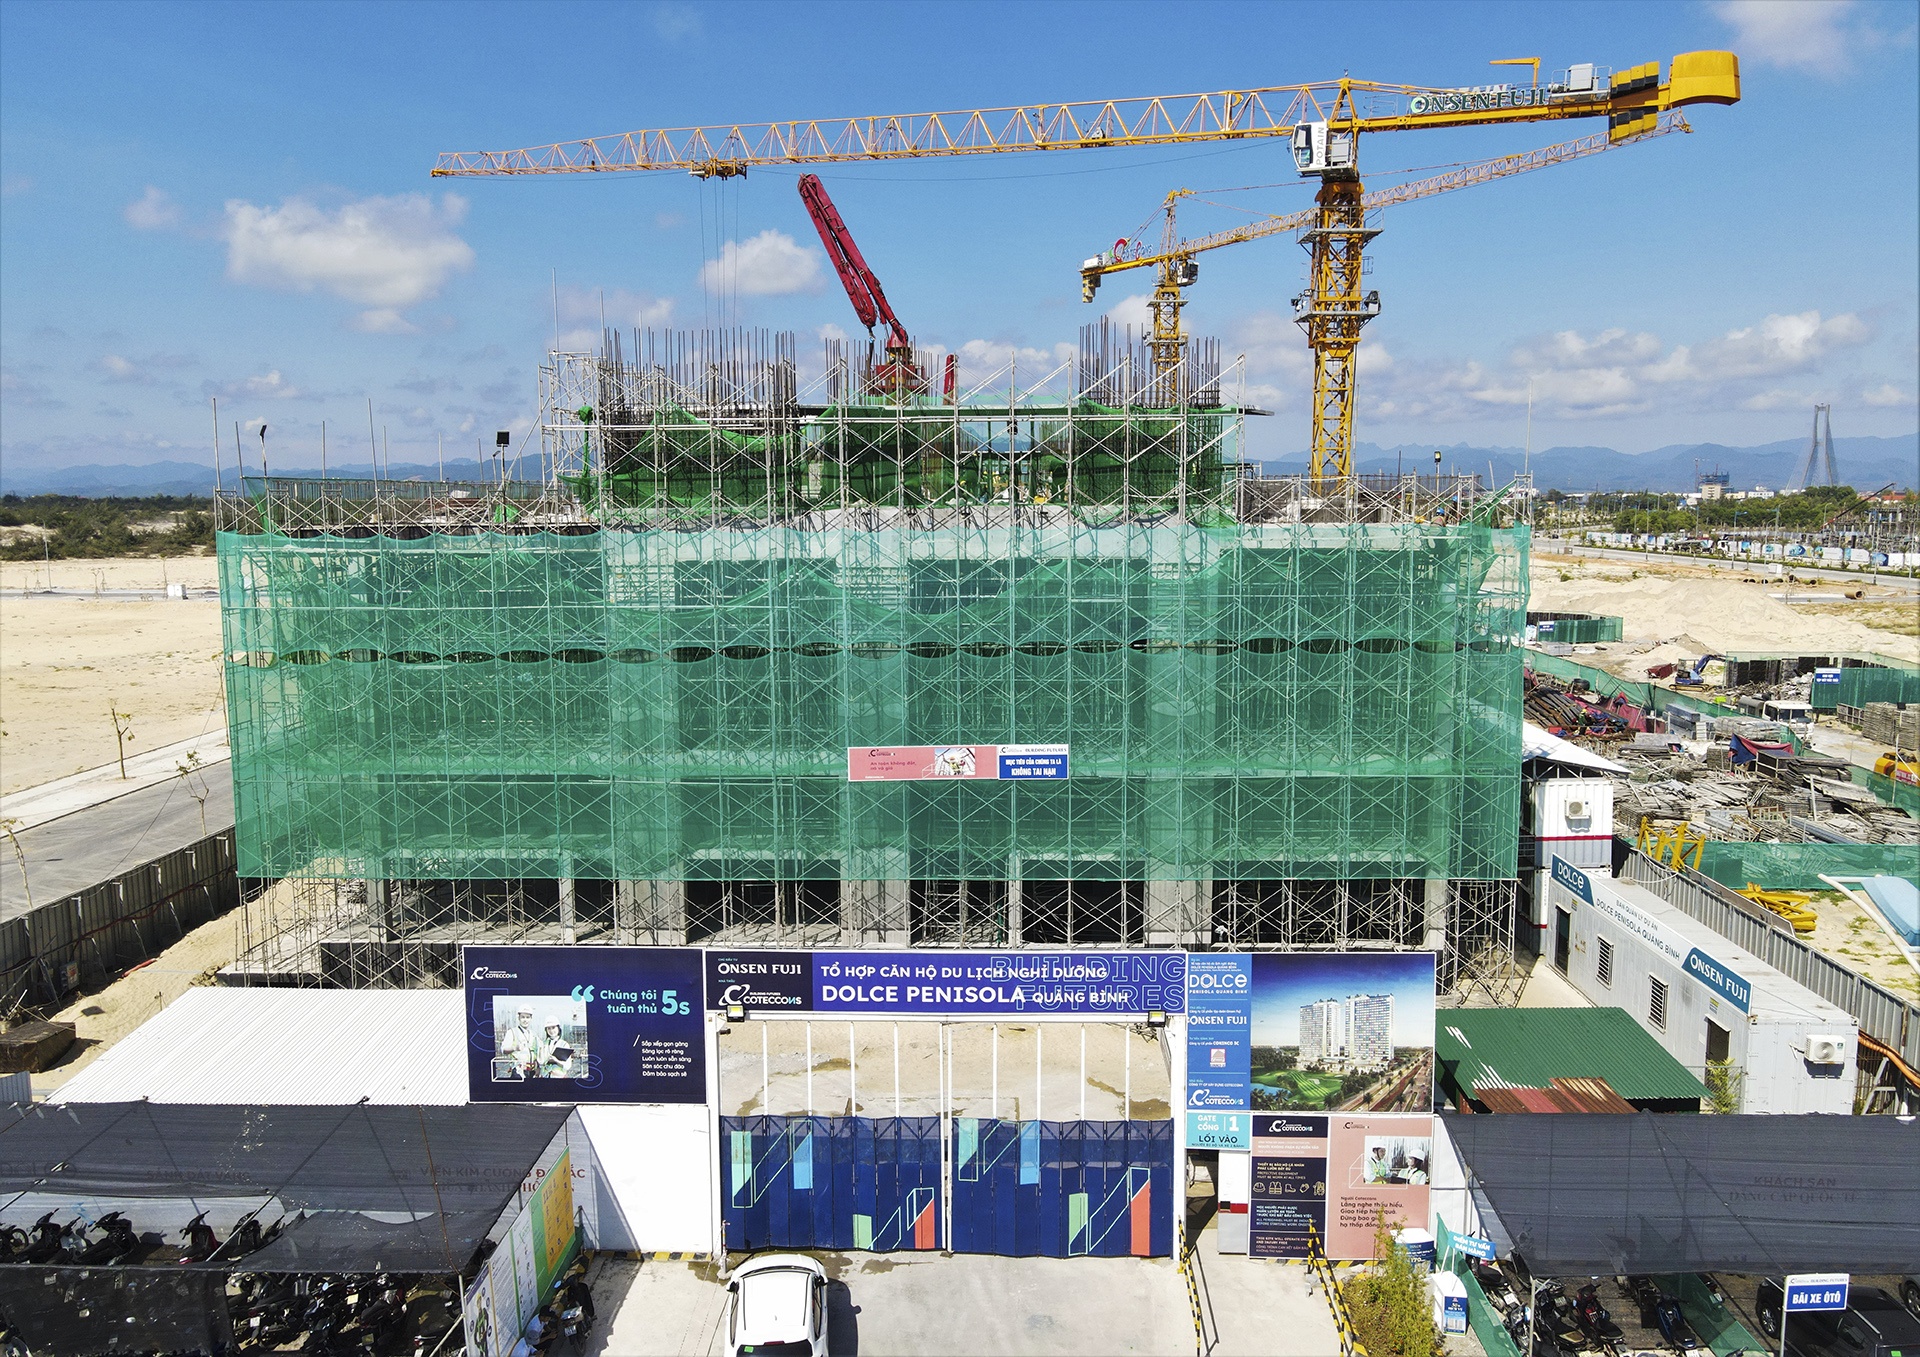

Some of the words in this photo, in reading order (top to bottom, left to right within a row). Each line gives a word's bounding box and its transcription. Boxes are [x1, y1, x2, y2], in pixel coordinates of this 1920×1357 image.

[1410, 93, 1491, 114] ONSEN
[1496, 88, 1547, 108] FUJI
[1315, 127, 1325, 165] POTAIN
[1011, 766, 1032, 776] KHÔNG
[1033, 767, 1042, 776] TAI
[1043, 767, 1056, 777] NẠN
[1596, 898, 1614, 917] DOLCE
[1614, 910, 1641, 936] PENISOLA
[717, 962, 768, 975] ONSEN
[771, 963, 802, 975] FUJI
[821, 961, 841, 978] TỔ
[845, 965, 876, 980] HỢP
[879, 964, 911, 978] CĂN
[915, 963, 938, 981] HỘ
[941, 967, 963, 978] DU
[967, 967, 1003, 981] LỊCH
[1007, 963, 1048, 979] NGHỈ
[1054, 964, 1108, 979] DƯỠNG
[1690, 954, 1724, 987] ONSEN
[1725, 977, 1748, 1003] FUJI
[600, 990, 638, 1002] Chúng
[640, 989, 658, 1000] tôi
[743, 996, 803, 1005] COTECCONS
[822, 985, 899, 1004] DOLCE
[906, 985, 1027, 1004] PENISOLA
[1032, 987, 1086, 1004] QUẢNG
[1089, 988, 1129, 1004] BÌNH
[607, 1003, 635, 1014] tuân
[638, 1002, 658, 1014] thủ
[661, 990, 691, 1016] 5s
[1189, 1015, 1224, 1025] ONSEN
[1226, 1015, 1248, 1025] FUJI
[1197, 1114, 1217, 1122] GATE
[1229, 1115, 1240, 1132] 1
[1197, 1121, 1220, 1131] CỔNG
[1198, 1132, 1216, 1143] LỐI
[1218, 1133, 1238, 1144] VÀO
[456, 1167, 479, 1177] KIM
[1356, 1207, 1368, 1215] tiếp
[1792, 1291, 1808, 1304] BÃI
[1809, 1293, 1822, 1304] XE
[1823, 1290, 1841, 1303] ÔTÔ
